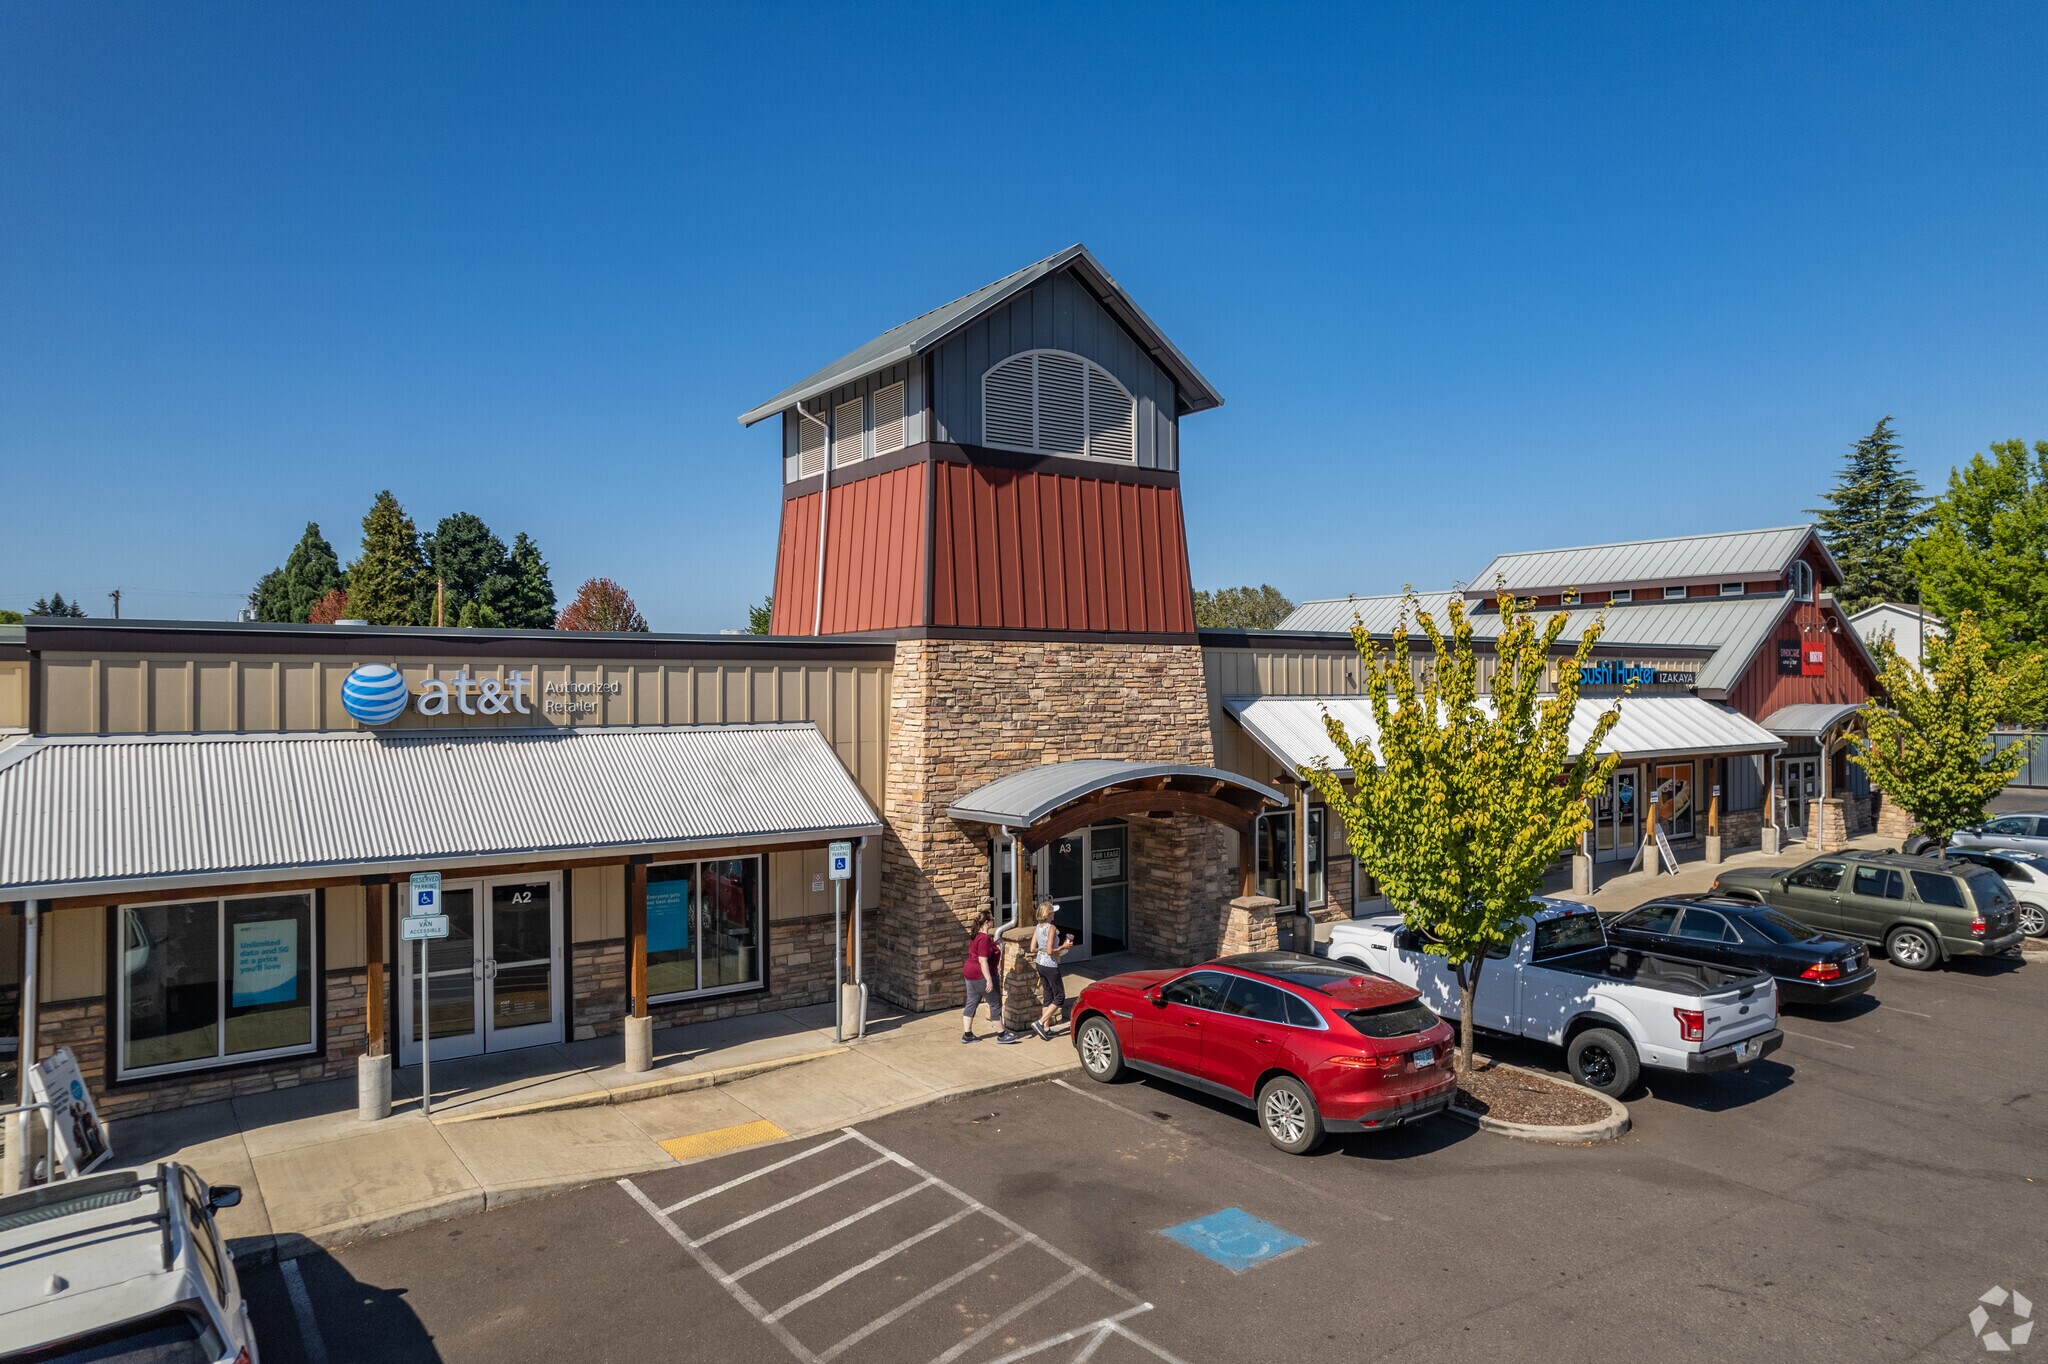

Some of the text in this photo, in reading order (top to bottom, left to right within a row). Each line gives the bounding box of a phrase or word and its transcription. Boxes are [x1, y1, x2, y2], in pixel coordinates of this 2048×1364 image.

[1579, 660, 1656, 685] Sushi Hunter
[1660, 673, 1694, 683] IZAKAYA
[417, 669, 531, 716] at&t
[545, 680, 620, 695] Authorized
[545, 701, 598, 714] Retailer
[1059, 843, 1072, 853] A3
[1092, 850, 1119, 860] FOR LEASE
[411, 875, 439, 884] RESERVED
[511, 891, 532, 905] A2
[409, 927, 442, 935] ACCESSIBLE
[240, 939, 281, 949] Unlimited
[240, 949, 259, 957] data
[257, 956, 278, 965] price
[240, 965, 263, 974] you'll
